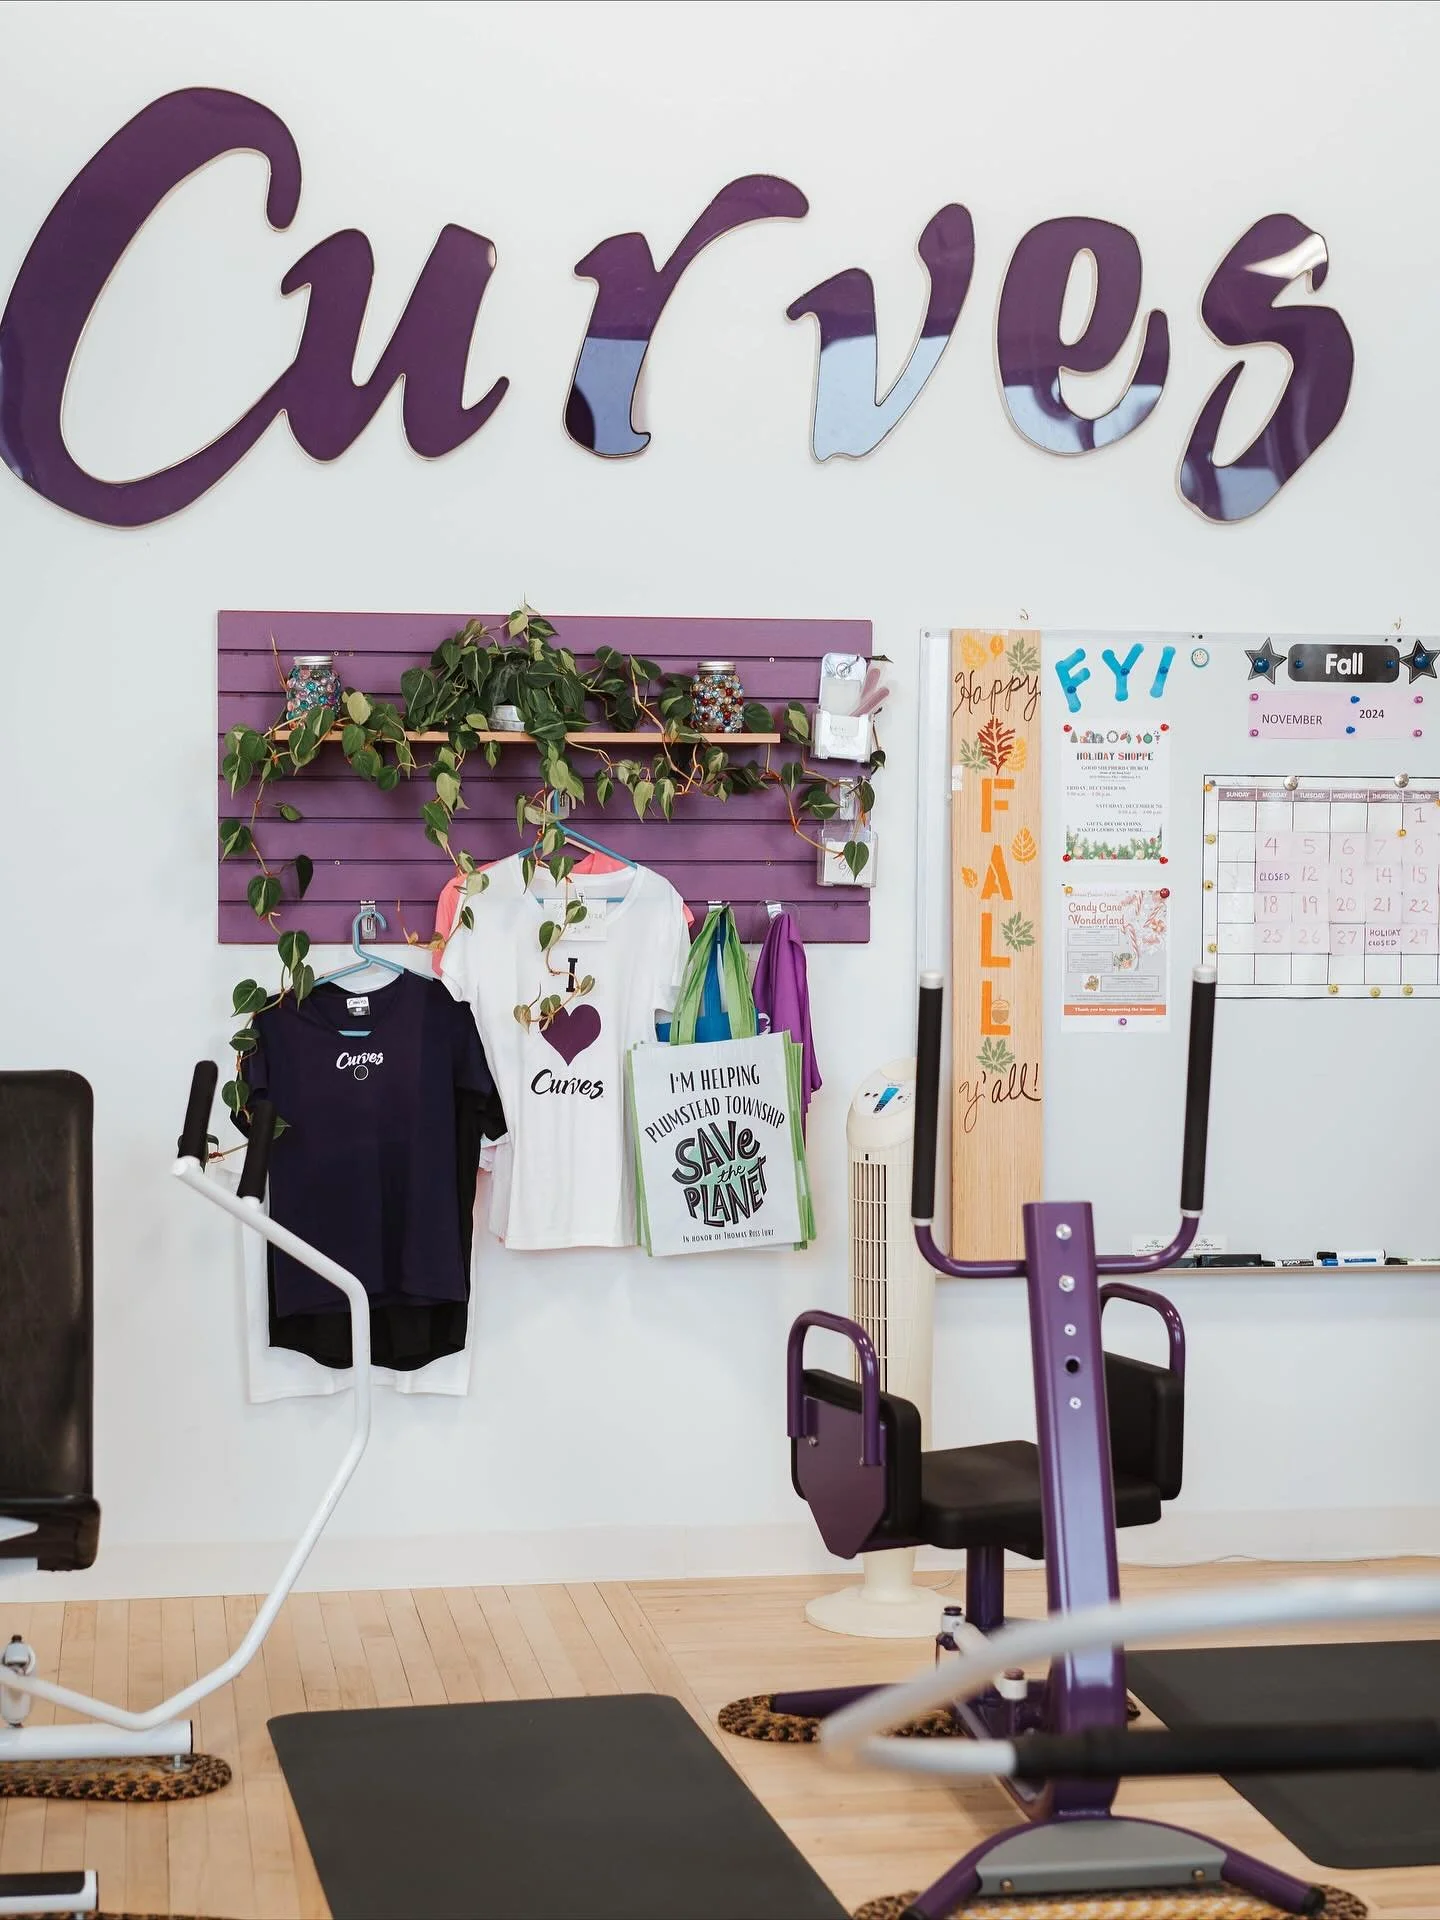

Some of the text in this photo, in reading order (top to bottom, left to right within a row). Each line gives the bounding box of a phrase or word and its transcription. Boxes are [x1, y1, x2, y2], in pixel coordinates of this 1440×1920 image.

[0, 85, 1356, 530] Curves
[1325, 652, 1363, 675] Fall
[953, 669, 1041, 721] Happy
[1262, 709, 1384, 725] NOVEMBER 2024
[1076, 751, 1153, 761] HOLIDAY SHOPPE
[1264, 837, 1280, 856] 4
[1303, 838, 1316, 854] 5
[1342, 838, 1355, 855] 6
[1374, 838, 1387, 854] 7
[1414, 838, 1424, 855] 8
[1259, 872, 1290, 882] CLOSED
[1301, 866, 1319, 882] 12
[1340, 867, 1354, 885] 13
[1375, 867, 1392, 883] 14
[1412, 866, 1428, 883] 15
[981, 778, 1014, 1035] FALL
[1068, 901, 1122, 914] Candy Cane
[1263, 895, 1278, 913] 18
[1302, 896, 1318, 914] 19
[1336, 897, 1356, 912] 20
[1373, 897, 1391, 912] 21
[1409, 898, 1432, 913] 22
[1068, 914, 1125, 925] Wonderland
[1263, 929, 1282, 943] 25
[1298, 930, 1320, 944] 26
[1337, 930, 1357, 945] 27
[1369, 929, 1401, 937] HOLIDAY
[1409, 929, 1429, 944] 29
[566, 957, 578, 993] I
[336, 1051, 384, 1070] Curves
[530, 1068, 604, 1100] Curves
[669, 1064, 760, 1094] I'M HELPING
[959, 1062, 1042, 1134] y'all!
[644, 1095, 785, 1144] PLUMSTEAD TOWNSHIP
[717, 1164, 746, 1184] the
[684, 1155, 768, 1228] PLANET
